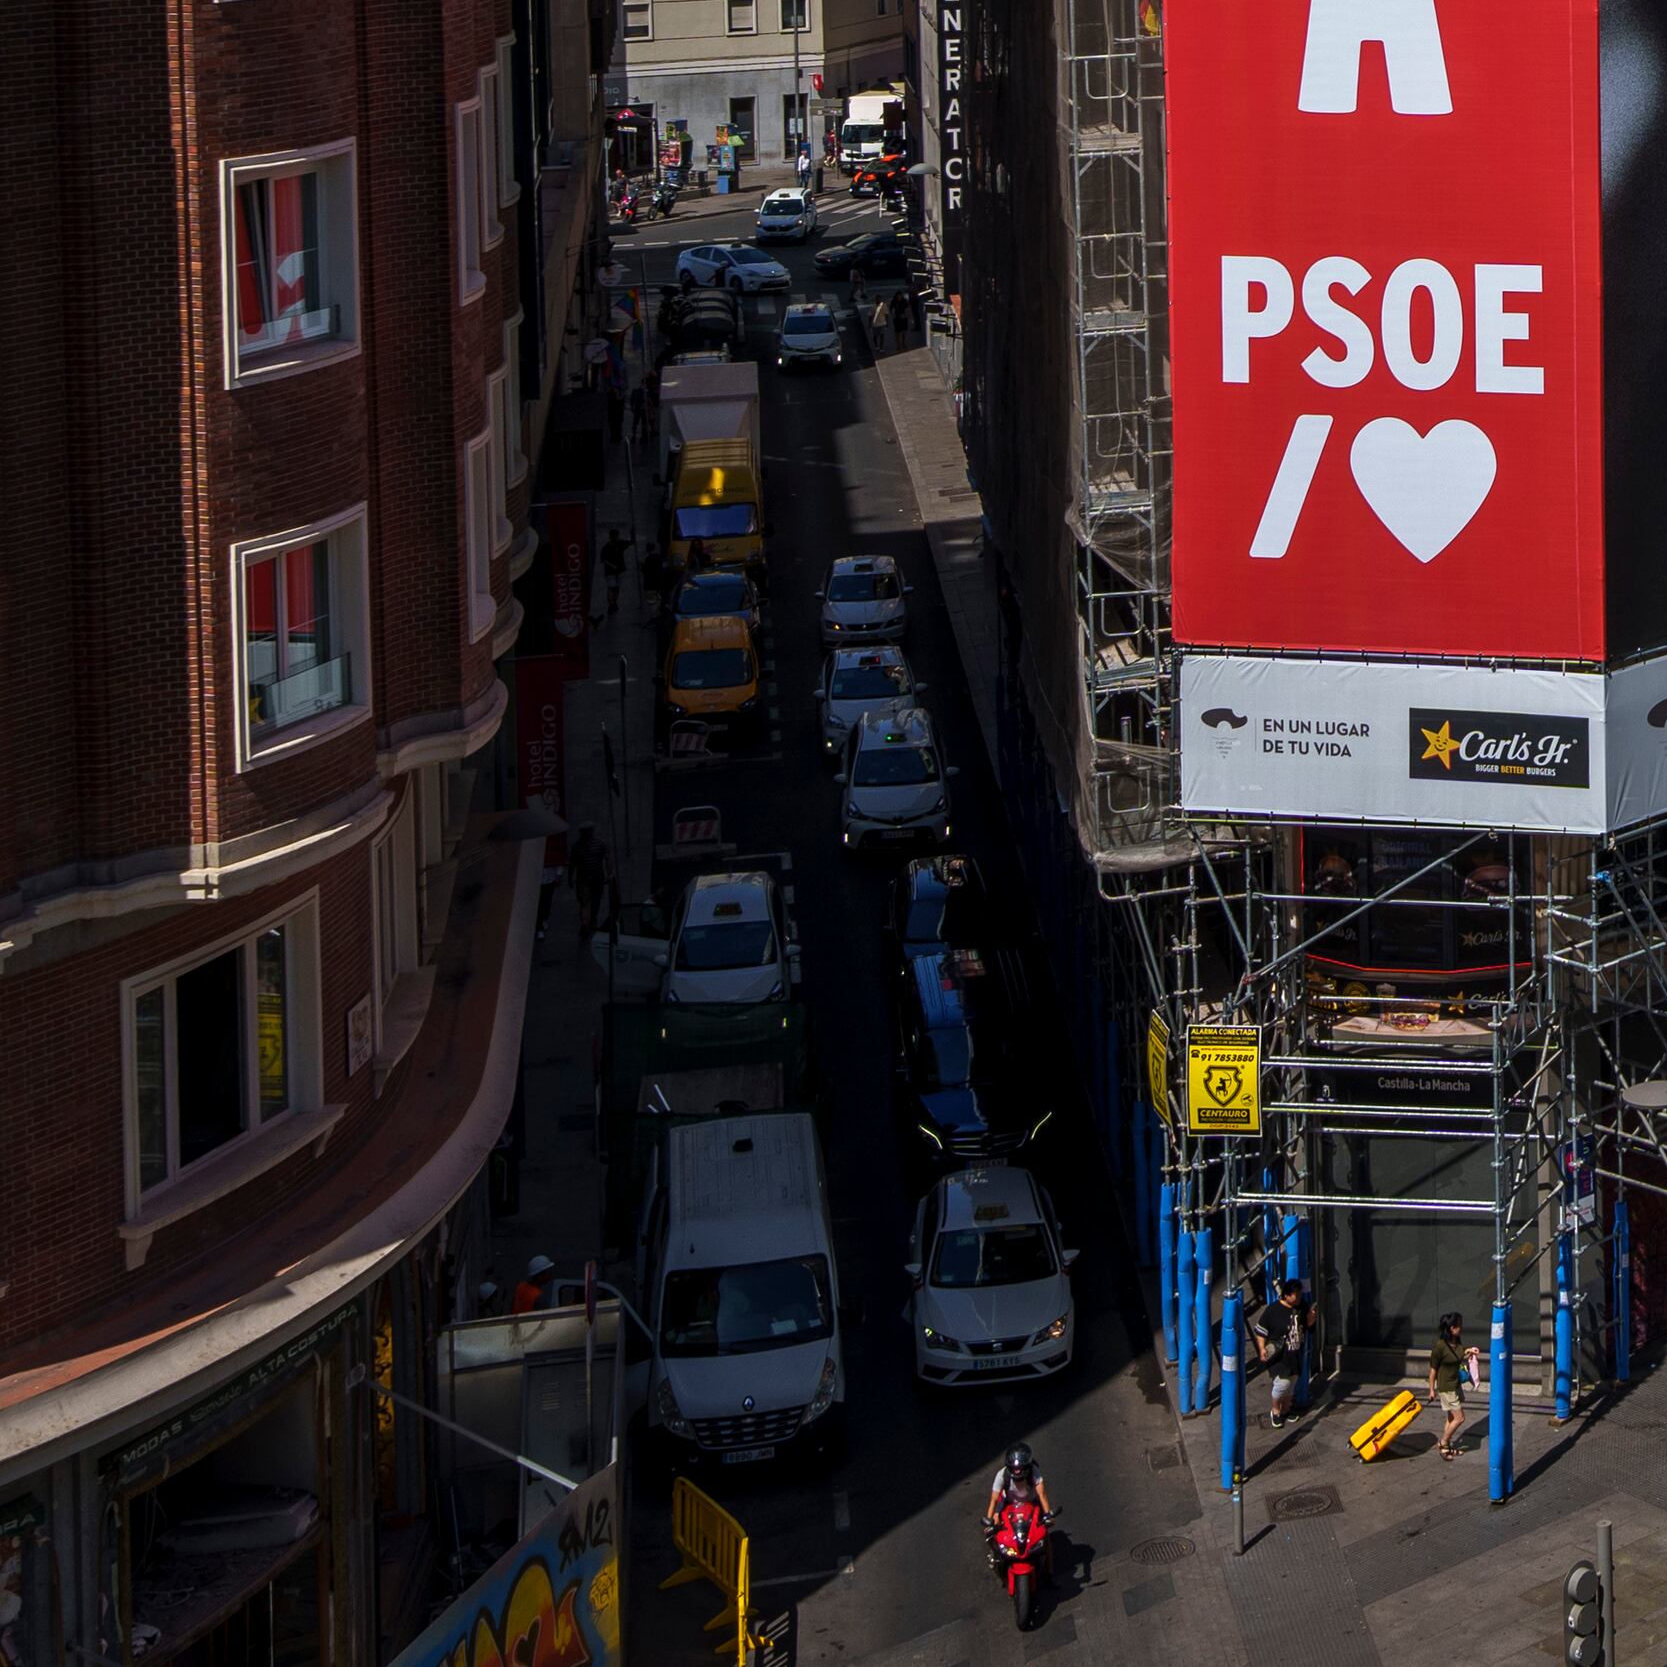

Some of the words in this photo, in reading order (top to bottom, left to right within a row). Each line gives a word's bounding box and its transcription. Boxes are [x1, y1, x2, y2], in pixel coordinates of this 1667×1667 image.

[1222, 255, 1545, 395] PSOE
[1262, 718, 1286, 733] EN
[1289, 719, 1312, 735] UN
[1315, 721, 1370, 738] LUGAR
[1262, 739, 1286, 754] DE
[1288, 740, 1311, 755] TU
[1313, 742, 1352, 758] VIDA
[1459, 730, 1530, 762] Carl's
[1533, 734, 1570, 765] Jr.
[1475, 763, 1500, 774] BIGGER
[1500, 764, 1525, 775] BETTER
[1526, 765, 1557, 777] BURGERS
[1190, 1028, 1218, 1036] ALARMA
[1218, 1028, 1257, 1037] CONECTADA
[1200, 1053, 1212, 1062] 91
[1214, 1054, 1255, 1062] 7853880
[1432, 1078, 1472, 1093] Mancha
[1199, 1109, 1248, 1118] CENTAURO
[248, 1352, 286, 1384] ALTA
[286, 1302, 362, 1359] COSTURA
[121, 1421, 183, 1464] MODAS
